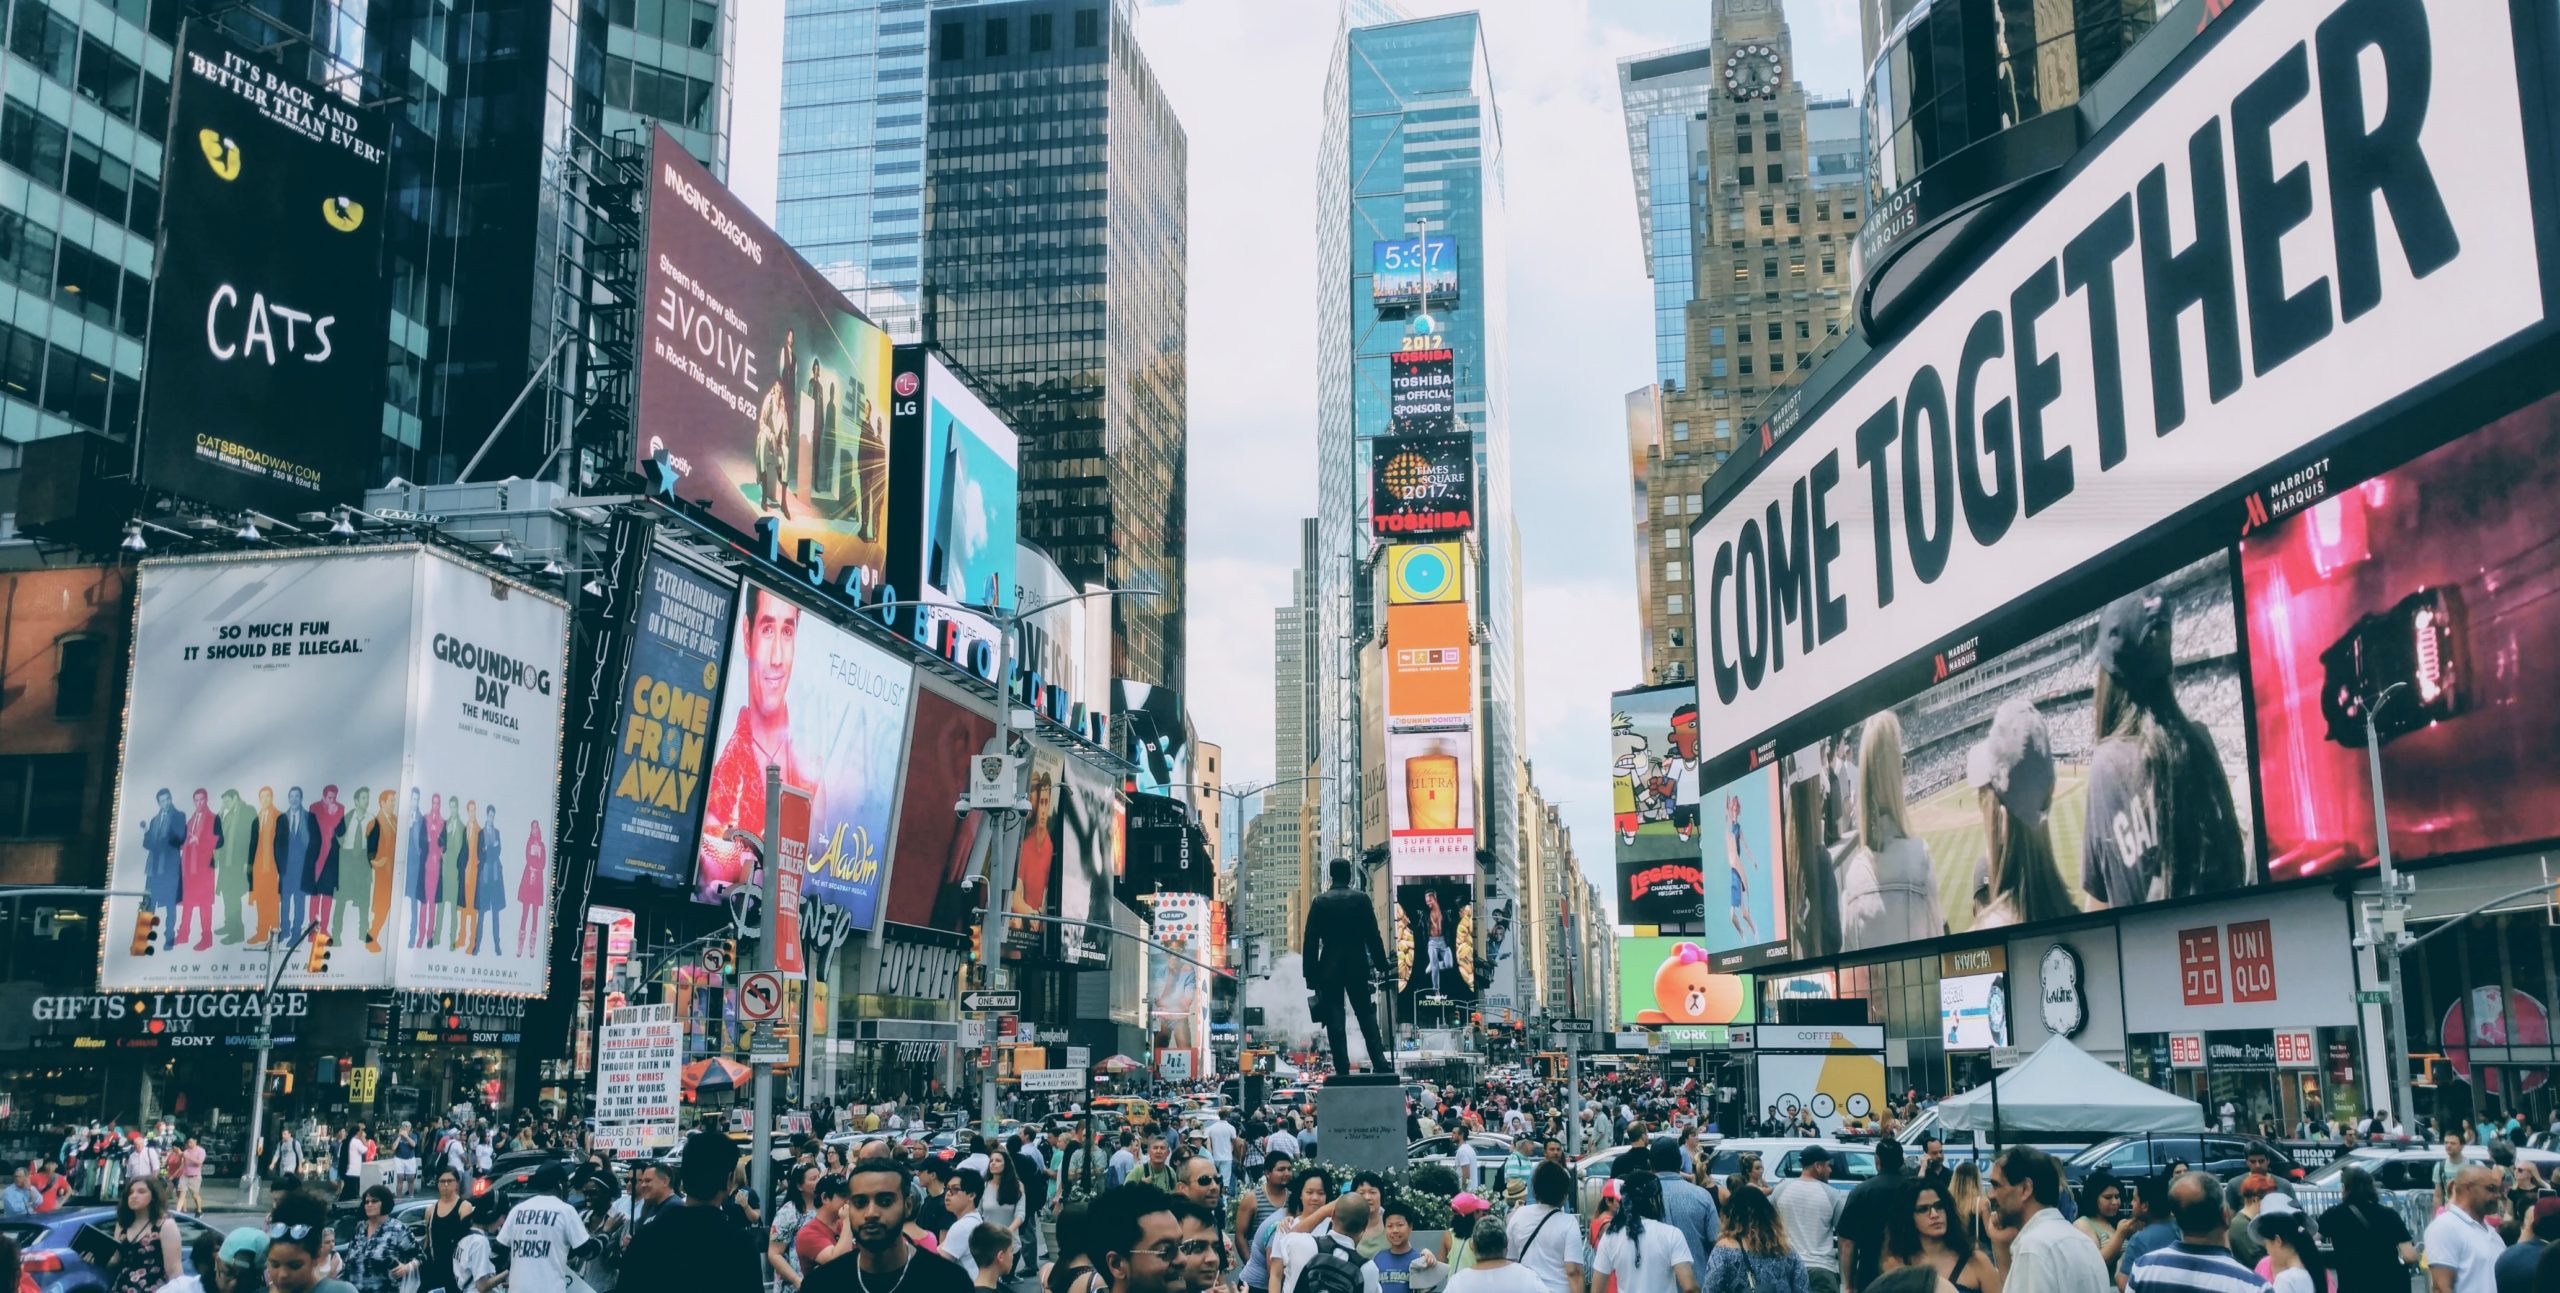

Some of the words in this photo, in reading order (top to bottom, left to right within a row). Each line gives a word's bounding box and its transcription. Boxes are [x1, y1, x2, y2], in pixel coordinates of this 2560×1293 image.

[224, 50, 260, 82] IT'S
[266, 72, 315, 111] BACK
[319, 103, 358, 132] AND
[188, 50, 268, 108] "BETTER
[273, 96, 326, 136] THAN
[330, 126, 386, 164] EVER!"
[664, 163, 711, 221] IMAGINE
[1863, 180, 1922, 243] MARRIOTT
[1864, 209, 1914, 264] MARQUIS
[1385, 242, 1444, 269] 5:37
[659, 253, 690, 290] Stream
[691, 279, 705, 302] the
[706, 293, 723, 316] new
[724, 308, 748, 336] album
[206, 283, 336, 365] CATS
[656, 286, 759, 393] EVOLVE
[1391, 349, 1453, 363] TOSHIBA
[1710, 448, 1849, 705] COME
[1856, 0, 2461, 608] TOGETHER
[655, 336, 665, 358] in
[665, 345, 688, 374] Rock
[689, 360, 705, 385] This
[705, 376, 736, 410] starting
[737, 396, 758, 421] 6/23
[1392, 374, 1452, 388] TOSHIBA
[1406, 389, 1452, 401] OFFICIAL
[895, 400, 917, 416] LG
[1393, 403, 1442, 416] SPONSOR
[1773, 390, 1802, 426] MARRIOTT
[1773, 408, 1799, 440] MARQUIS
[196, 432, 321, 483] CATSBROADWAY.COM
[203, 449, 218, 462] Neil
[218, 452, 240, 466] Simon
[241, 457, 267, 475] Theatre
[272, 470, 286, 481] 250
[1415, 465, 1449, 475] TIMES
[1421, 472, 1465, 484] SQUARE
[2271, 457, 2330, 498] MARRIOTT
[1403, 484, 1448, 500] 2017
[2272, 480, 2324, 516] MARQUIS
[381, 508, 441, 523] LAMAR
[1375, 510, 1471, 532] TOSHIBA
[659, 596, 705, 633] TRANSPORTS
[704, 616, 715, 637] US
[248, 622, 293, 638] MUCH
[299, 621, 330, 636] FUN
[648, 612, 660, 633] ON
[659, 619, 666, 637] A
[667, 620, 688, 646] WAVE
[688, 628, 699, 650] OF
[183, 646, 200, 661] IT
[206, 644, 266, 660] SHOULD
[271, 642, 292, 657] BE
[1948, 636, 1979, 659] MARRIOTT
[432, 632, 551, 696] GROUNDHOG
[1949, 651, 1977, 672] MARQUIS
[474, 675, 510, 709] DAY
[633, 674, 711, 736] COME
[462, 702, 479, 719] THE
[481, 708, 519, 731] MUSICAL
[623, 713, 705, 775] FROM
[1757, 739, 1777, 754] MARRIOTT
[1758, 752, 1775, 764] MARQUIS
[615, 757, 699, 814] AWAY
[1411, 777, 1454, 789] ULTRA
[780, 836, 804, 858] BETTE
[1179, 827, 1189, 869] 1500
[1398, 845, 1432, 853] LIGHT
[1439, 844, 1469, 852] BEER
[1403, 836, 1463, 845] SUPERIOR
[806, 820, 878, 887] Aladdin
[811, 878, 820, 887] THE
[828, 881, 851, 892] BROADWAY
[851, 887, 868, 897] MUSICAL
[1651, 884, 1691, 892] CHAMBERLAIN
[1658, 889, 1683, 897] HEIGHTS
[2233, 930, 2265, 960] UNI
[170, 964, 201, 973] NOW
[211, 964, 229, 972] ON
[877, 938, 962, 1000] FOREVER
[1954, 950, 1992, 971] INVICTA
[427, 963, 448, 973] NOW
[453, 965, 466, 975] ON
[471, 967, 519, 979] BROADWAY
[2235, 963, 2271, 997] QLO
[32, 994, 126, 1021] GIFTS
[151, 992, 308, 1018] LUGGAGE
[453, 992, 526, 1018] LUGGAGE
[977, 997, 995, 1006] ONE
[996, 996, 1013, 1005] WAY
[2357, 993, 2366, 1002] W
[2368, 993, 2380, 1002] 46
[613, 1008, 638, 1025] WORD
[641, 1007, 651, 1023] OF
[654, 1005, 672, 1022] GOD
[163, 1019, 193, 1033] NY
[608, 1028, 626, 1037] ONLY
[631, 1027, 641, 1036] BY
[1675, 1029, 1707, 1039] YORK
[1797, 1030, 1844, 1041] COFFEED
[73, 1036, 107, 1048] Nikon
[171, 1035, 215, 1046] SONY
[415, 1030, 438, 1042] Nikon
[472, 1032, 500, 1042] SONY
[2187, 1038, 2198, 1048] UNI
[2296, 1035, 2308, 1046] UNI
[602, 1051, 616, 1060] YOU
[619, 1050, 634, 1059] CAN
[637, 1050, 647, 1058] BE
[650, 1048, 675, 1057] SAVED
[897, 1041, 933, 1062] FOREVER
[932, 1041, 942, 1062] 21
[2188, 1049, 2199, 1060] QLO
[2211, 1044, 2242, 1059] LifeWear
[2245, 1043, 2275, 1058] Pop-Up
[2296, 1047, 2310, 1059] QLO
[600, 1061, 634, 1072] THROUGH
[637, 1060, 659, 1070] FAITH
[662, 1060, 671, 1069] IN
[352, 1070, 362, 1098] ATM
[366, 1069, 374, 1097] ATM
[609, 1073, 631, 1083] JESUS
[636, 1072, 664, 1082] CHRIST
[607, 1085, 621, 1095] NOT
[624, 1085, 634, 1093] BY
[638, 1083, 666, 1093] WORKS
[602, 1097, 613, 1106] SO
[616, 1096, 633, 1105] THAT
[637, 1096, 648, 1104] NO
[651, 1095, 668, 1104] MAN
[597, 1108, 612, 1118] CAN
[595, 1127, 624, 1137] JESUS
[626, 1126, 635, 1136] IS
[635, 1126, 655, 1136] THE
[657, 1125, 676, 1136] ONLY
[594, 1138, 615, 1148] WAY
[619, 1137, 632, 1146] TO
[617, 1150, 637, 1158] JOHN
[515, 1208, 560, 1227] REPENT
[512, 1239, 552, 1259] PERISH
